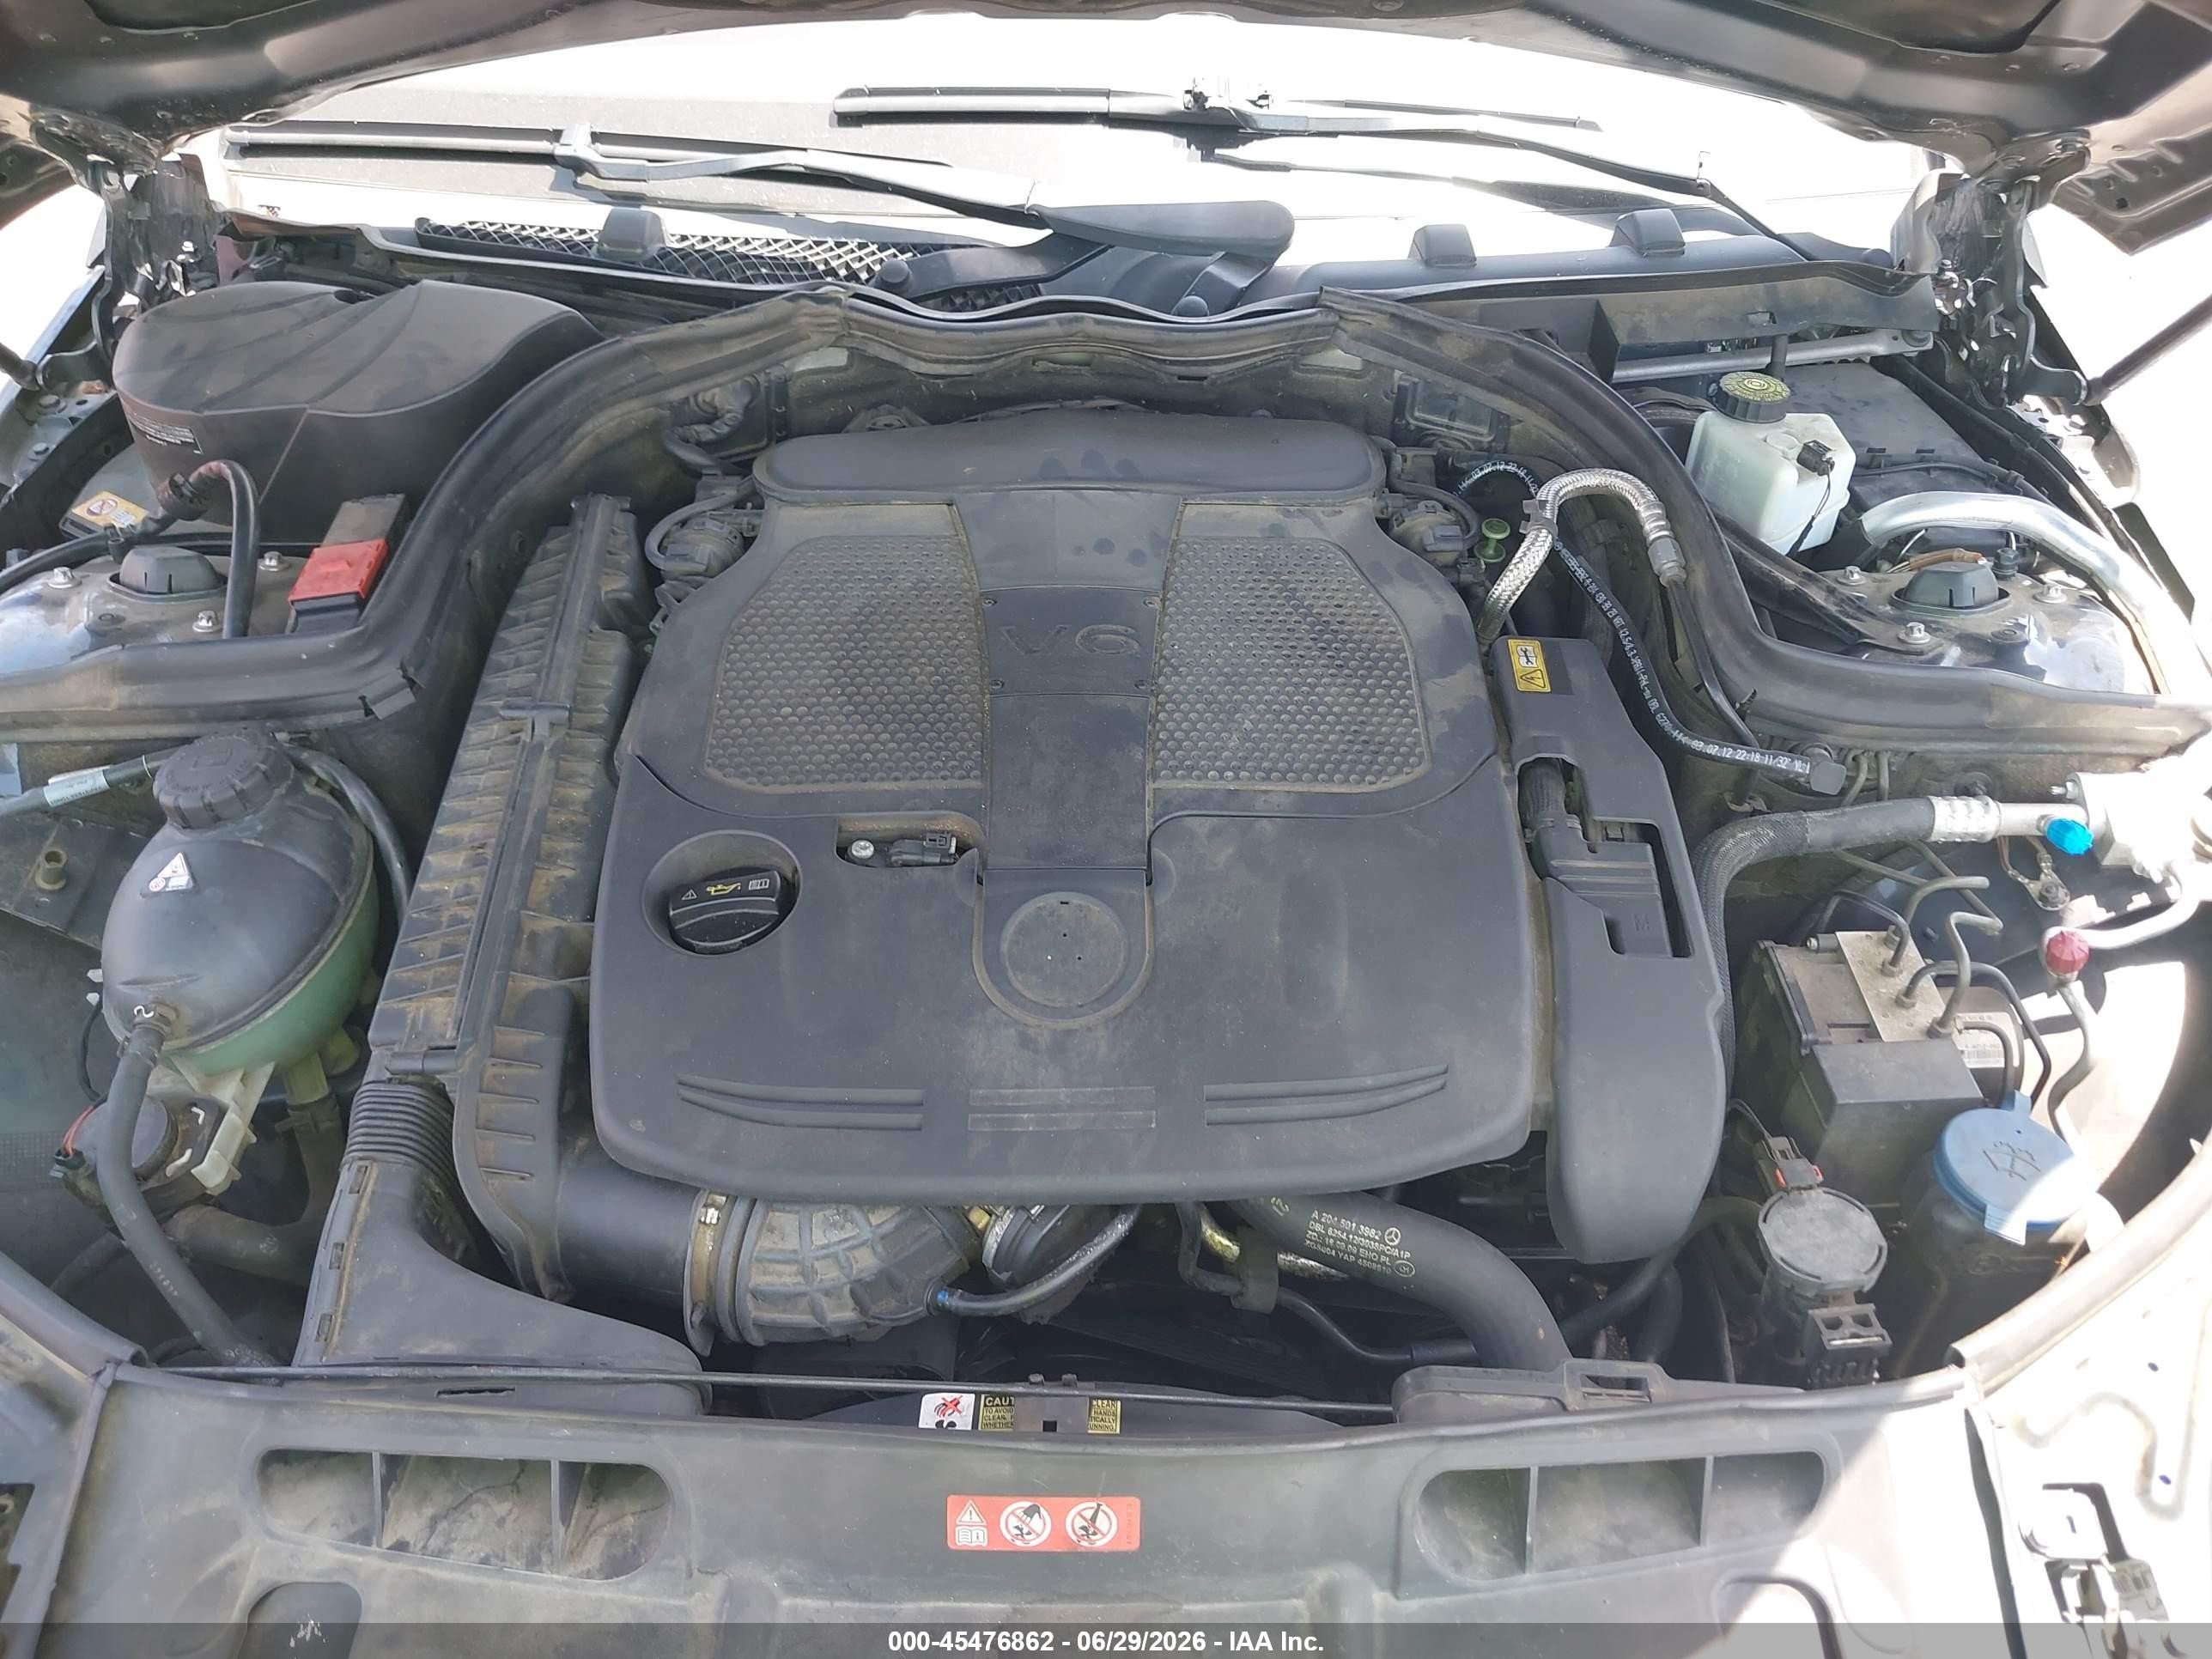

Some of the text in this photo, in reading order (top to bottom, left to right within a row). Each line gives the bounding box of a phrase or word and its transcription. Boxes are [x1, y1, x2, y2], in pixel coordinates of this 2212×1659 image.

[997, 623, 1141, 656] V6
[1735, 749, 1760, 763] 22:18
[1310, 1209, 1319, 1220] A
